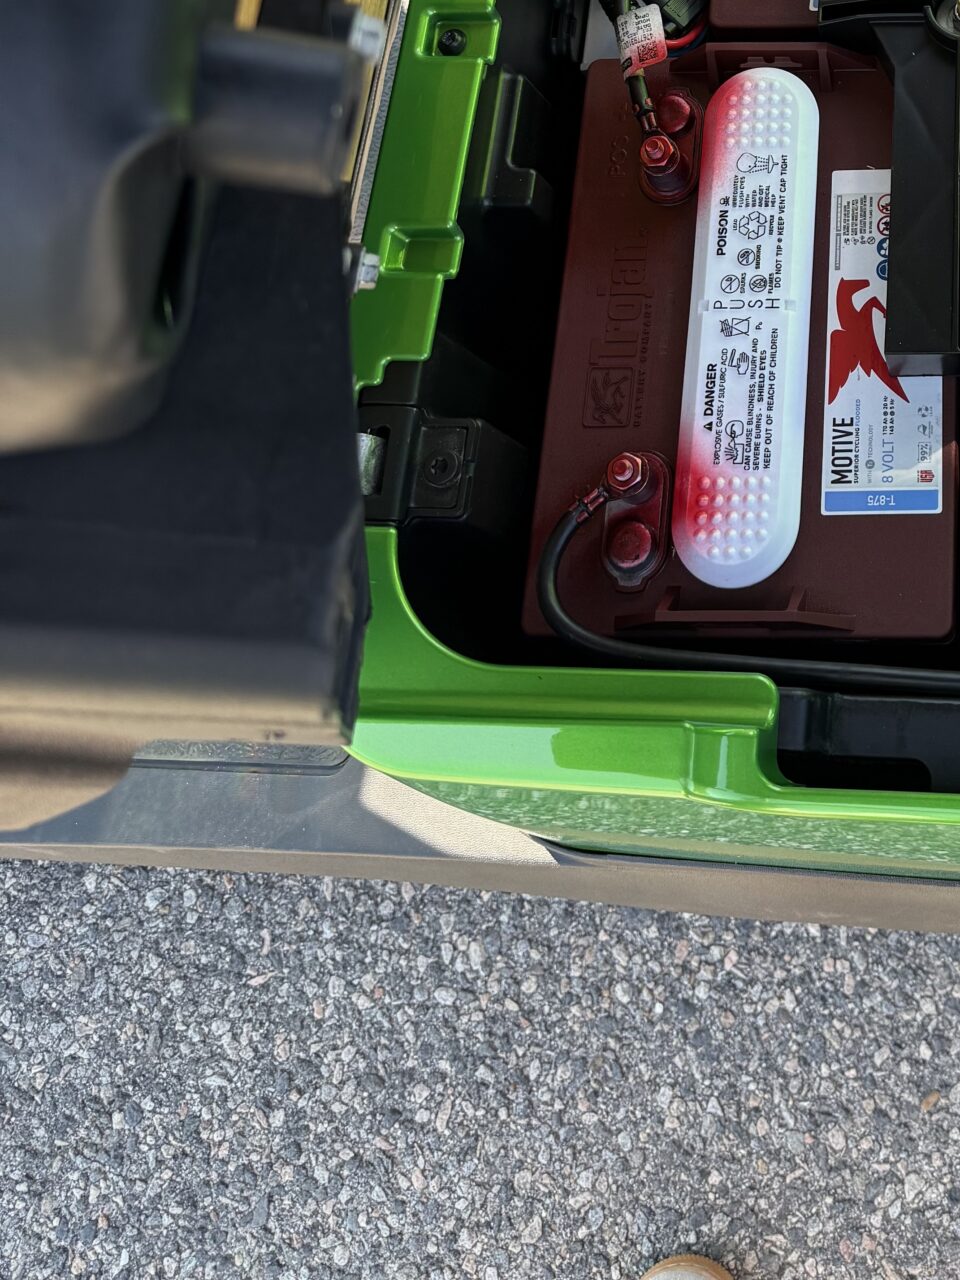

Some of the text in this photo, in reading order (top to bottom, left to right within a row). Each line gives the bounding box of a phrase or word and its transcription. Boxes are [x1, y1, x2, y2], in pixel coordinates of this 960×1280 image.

[716, 210, 728, 256] POISON
[775, 277, 781, 288] DO
[588, 240, 654, 366] Trojan
[714, 298, 780, 309] PUSH
[718, 368, 727, 398] SULFURIC
[750, 355, 758, 379] INJURY
[704, 363, 717, 417] DANGER
[747, 381, 756, 425] BLINDNESS,
[763, 328, 778, 469] KEEP OUT OF REACH OF CHILDREN
[716, 404, 724, 427] GASES
[753, 442, 761, 470] SEVERE
[757, 373, 765, 402] SHIELD
[713, 429, 722, 465] EXPLOSIVE
[745, 428, 753, 453] CAUSE
[831, 417, 853, 485] MOTIVE
[882, 439, 894, 472] VOLT
[920, 443, 928, 461] 99%
[867, 495, 896, 505] T-875
